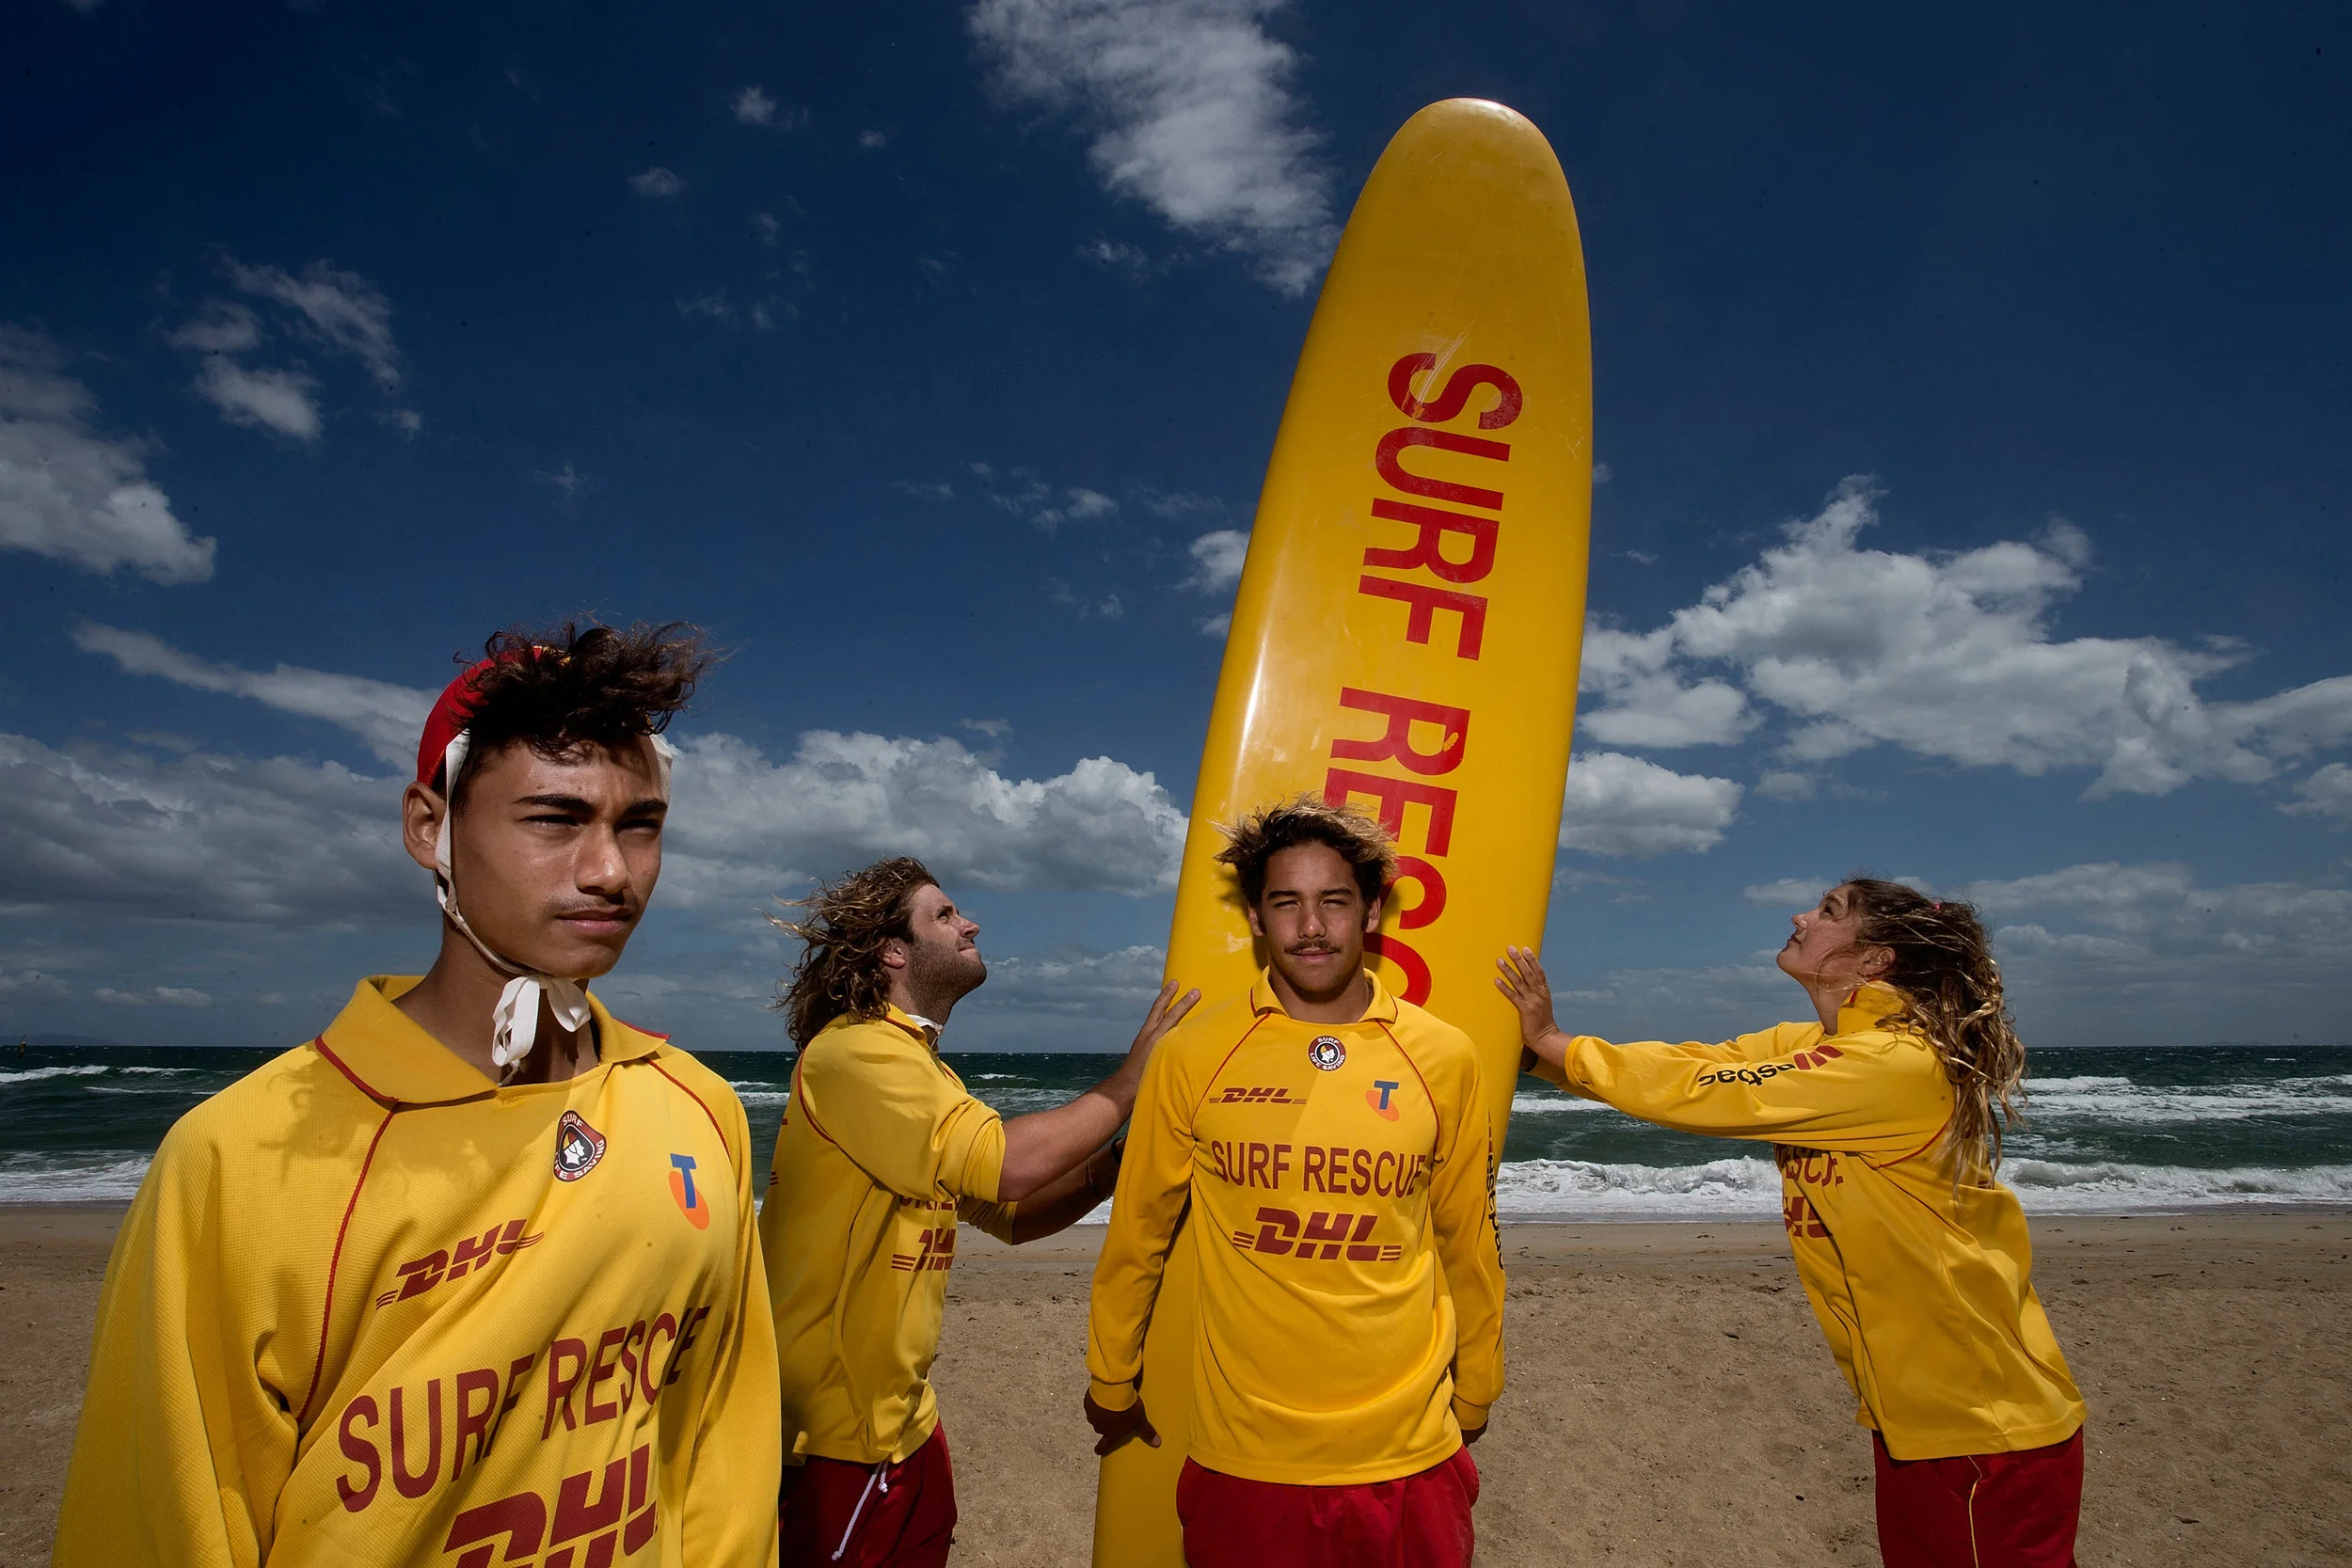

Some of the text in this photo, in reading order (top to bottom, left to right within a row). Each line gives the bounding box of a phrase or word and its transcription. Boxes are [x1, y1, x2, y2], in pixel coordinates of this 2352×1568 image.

[1359, 352, 1524, 660] SURF
[1310, 1053, 1345, 1070] LIFE SAVING
[562, 1114, 584, 1127] SURF
[1221, 1087, 1293, 1105] DHL
[573, 1139, 605, 1179] SAVING
[1211, 1140, 1427, 1198] SURF RESCUE
[396, 1219, 530, 1302] DHL
[1254, 1207, 1381, 1261] DHL
[336, 1352, 536, 1513] SURF
[442, 1443, 657, 1568] DHL
